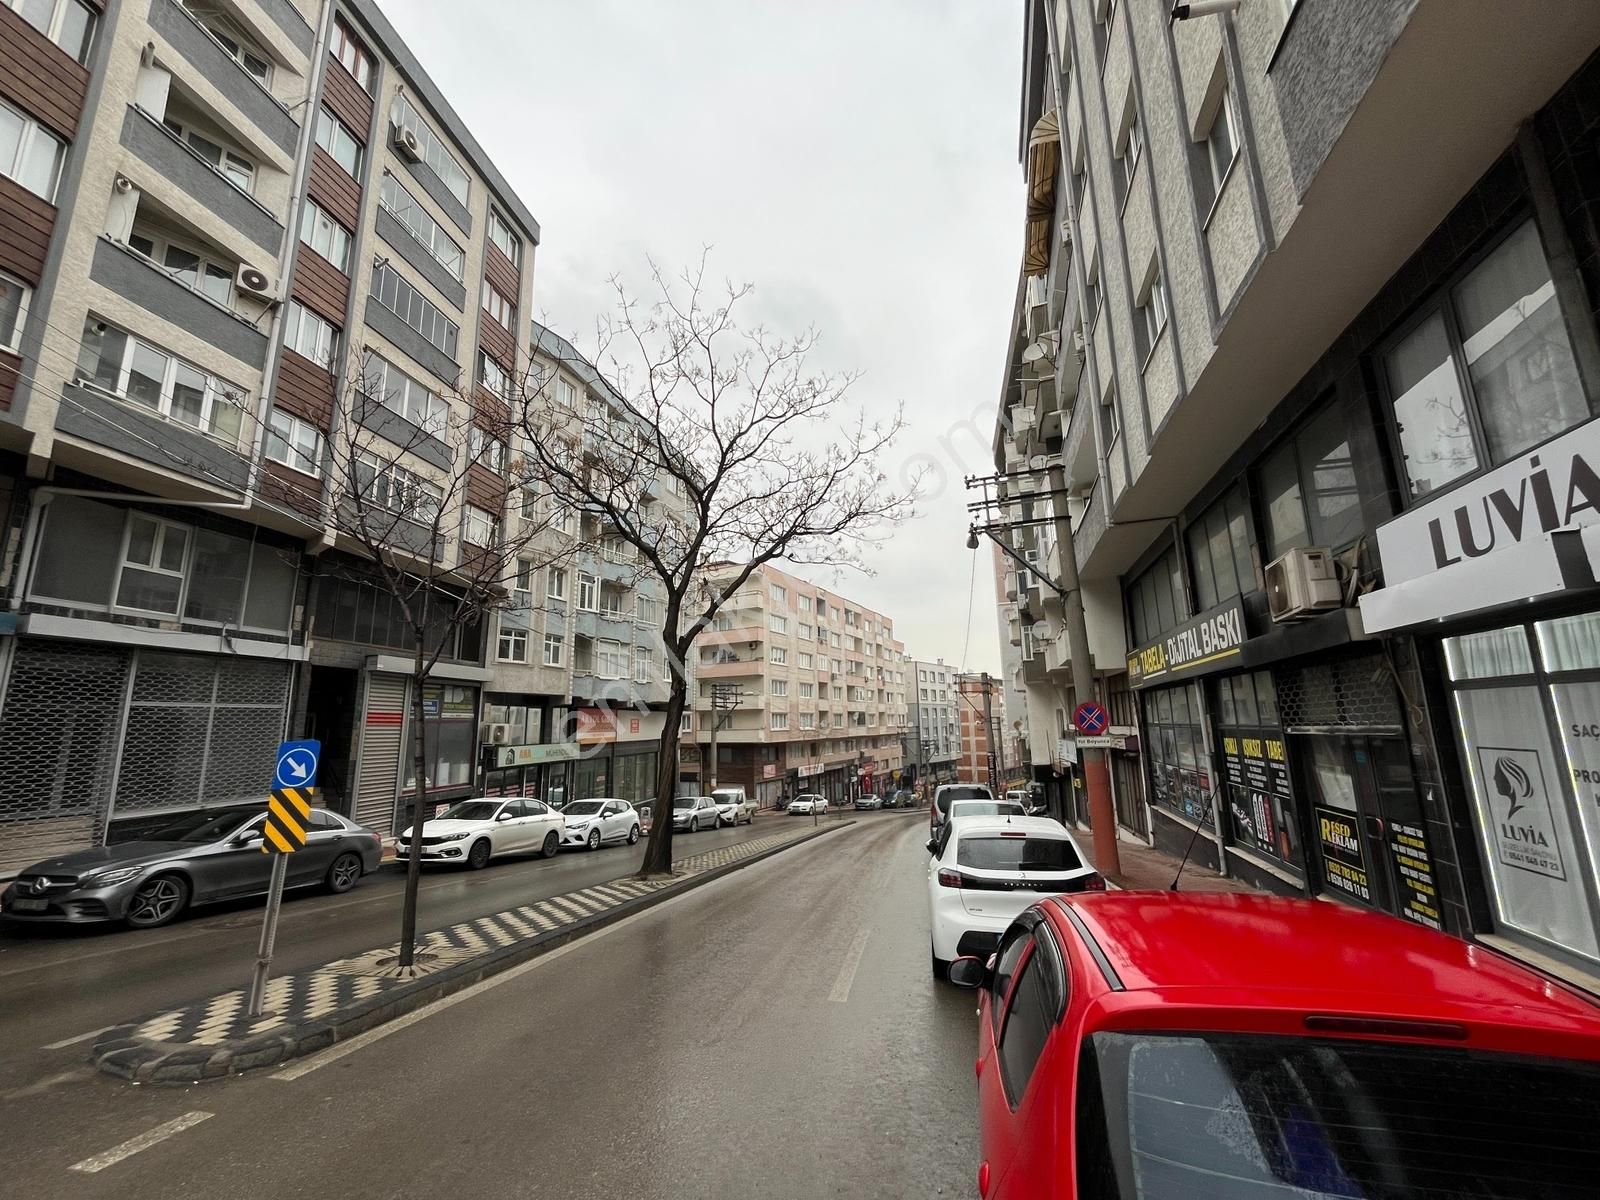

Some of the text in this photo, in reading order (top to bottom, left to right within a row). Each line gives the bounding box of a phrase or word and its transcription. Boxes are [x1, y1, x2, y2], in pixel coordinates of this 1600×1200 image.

[1140, 643, 1166, 675] TABELA
[1201, 607, 1242, 655] BASKI
[1501, 823, 1549, 848] LUVİA
